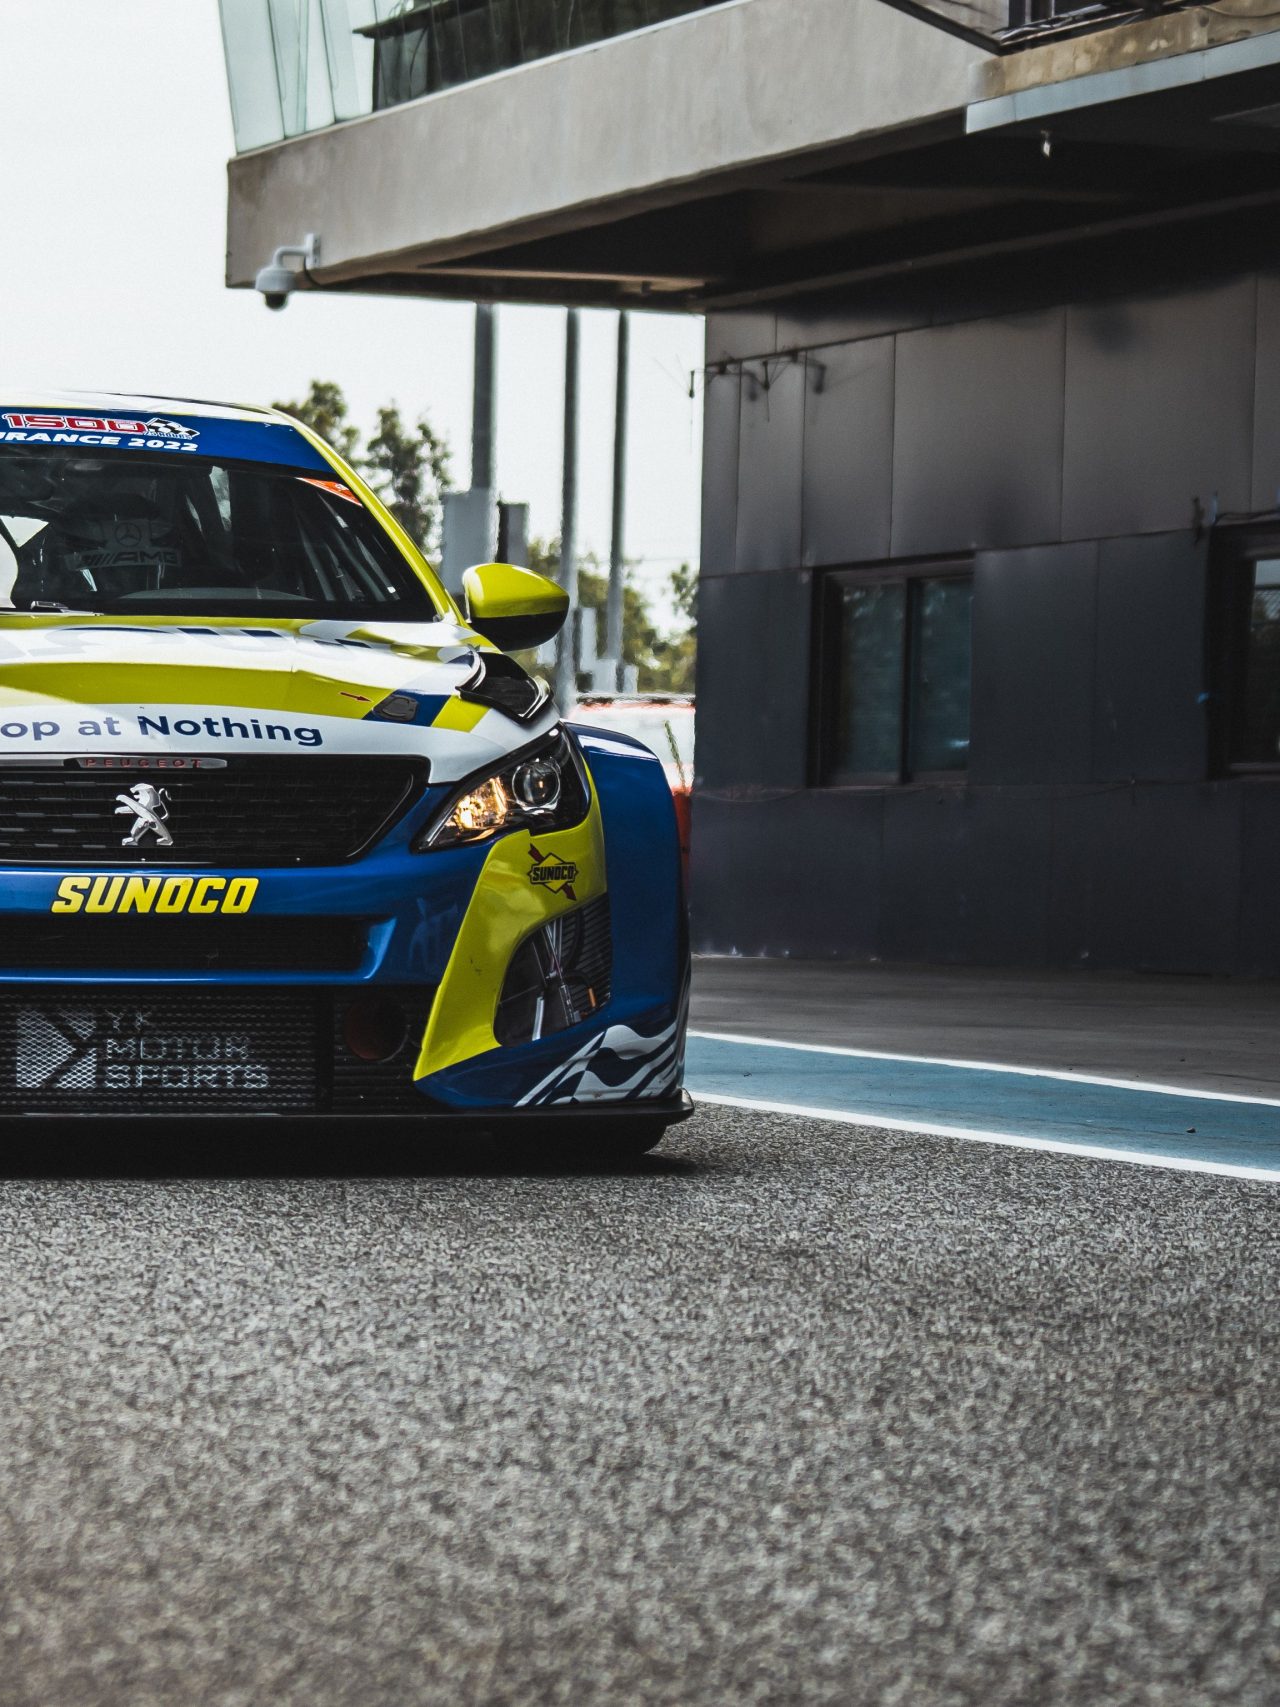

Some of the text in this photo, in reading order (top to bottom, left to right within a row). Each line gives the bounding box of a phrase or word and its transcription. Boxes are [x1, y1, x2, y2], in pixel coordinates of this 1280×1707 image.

[1, 413, 149, 435] 1500
[128, 437, 199, 452] 2022
[78, 715, 121, 736] at
[137, 714, 323, 747] Nothing
[84, 758, 202, 769] PEUGEOT
[532, 865, 575, 881] SUNOCO
[50, 876, 260, 914] SUNOCO
[106, 1035, 251, 1060] MOTOR
[104, 1064, 270, 1089] SPORTS
